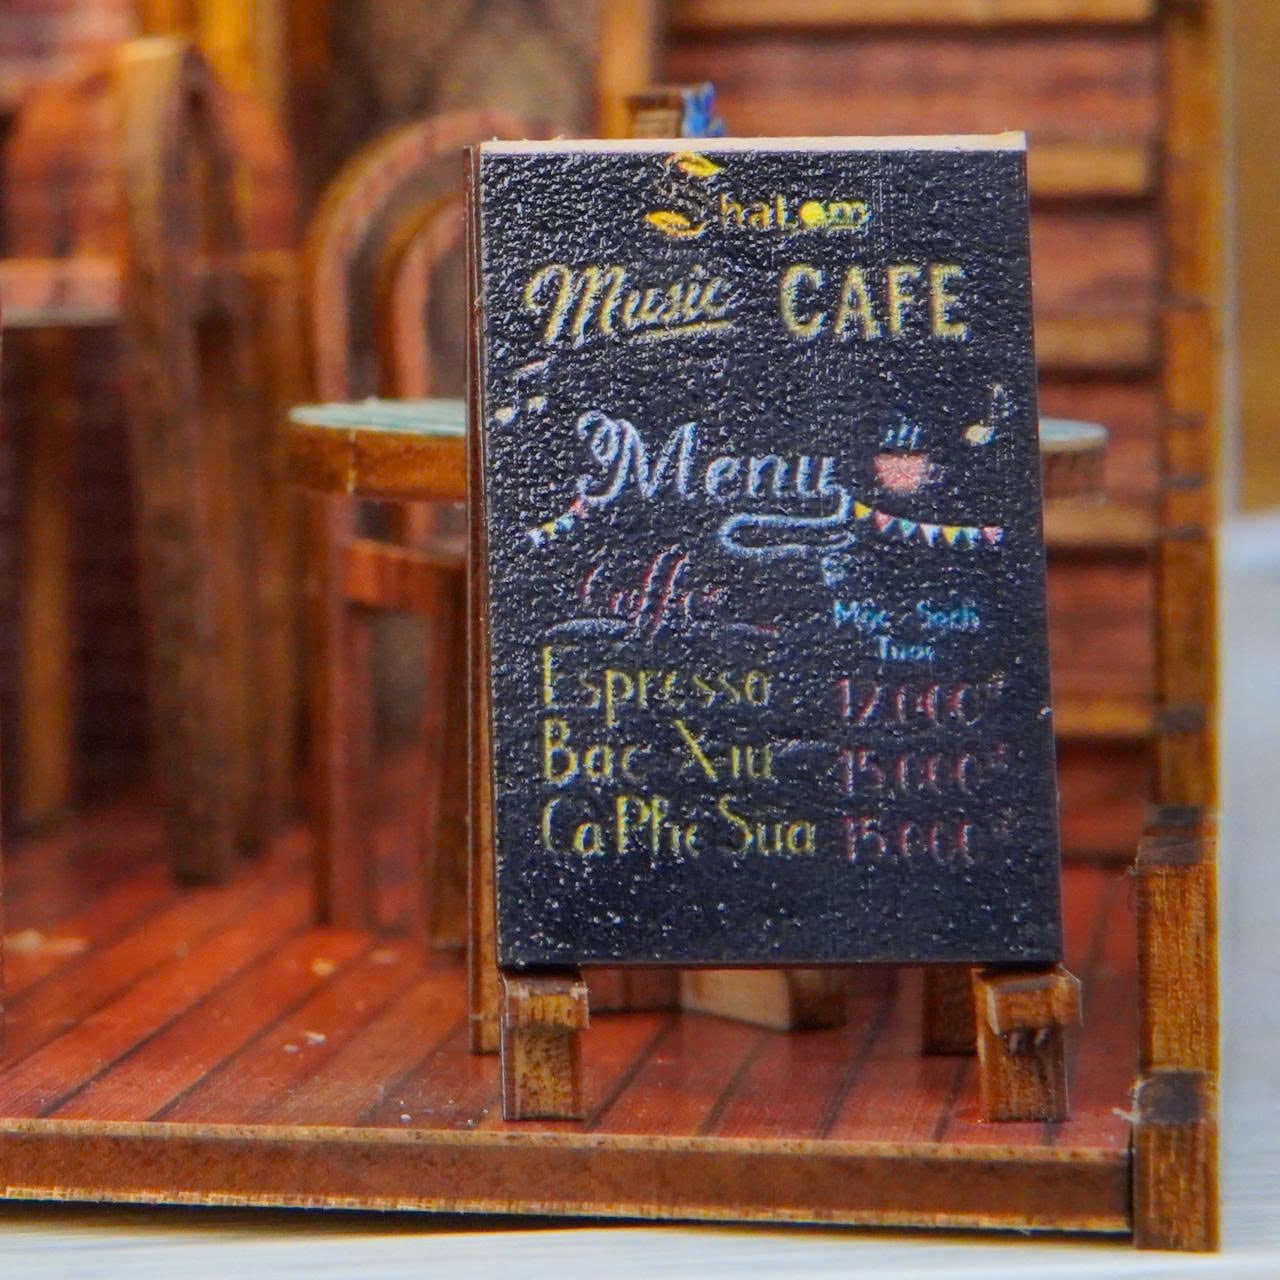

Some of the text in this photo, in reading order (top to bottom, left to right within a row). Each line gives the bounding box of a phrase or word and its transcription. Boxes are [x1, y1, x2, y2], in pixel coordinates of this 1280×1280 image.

[523, 262, 969, 348] Music CAFE
[576, 409, 854, 526] Menu
[540, 642, 771, 726] Espresso
